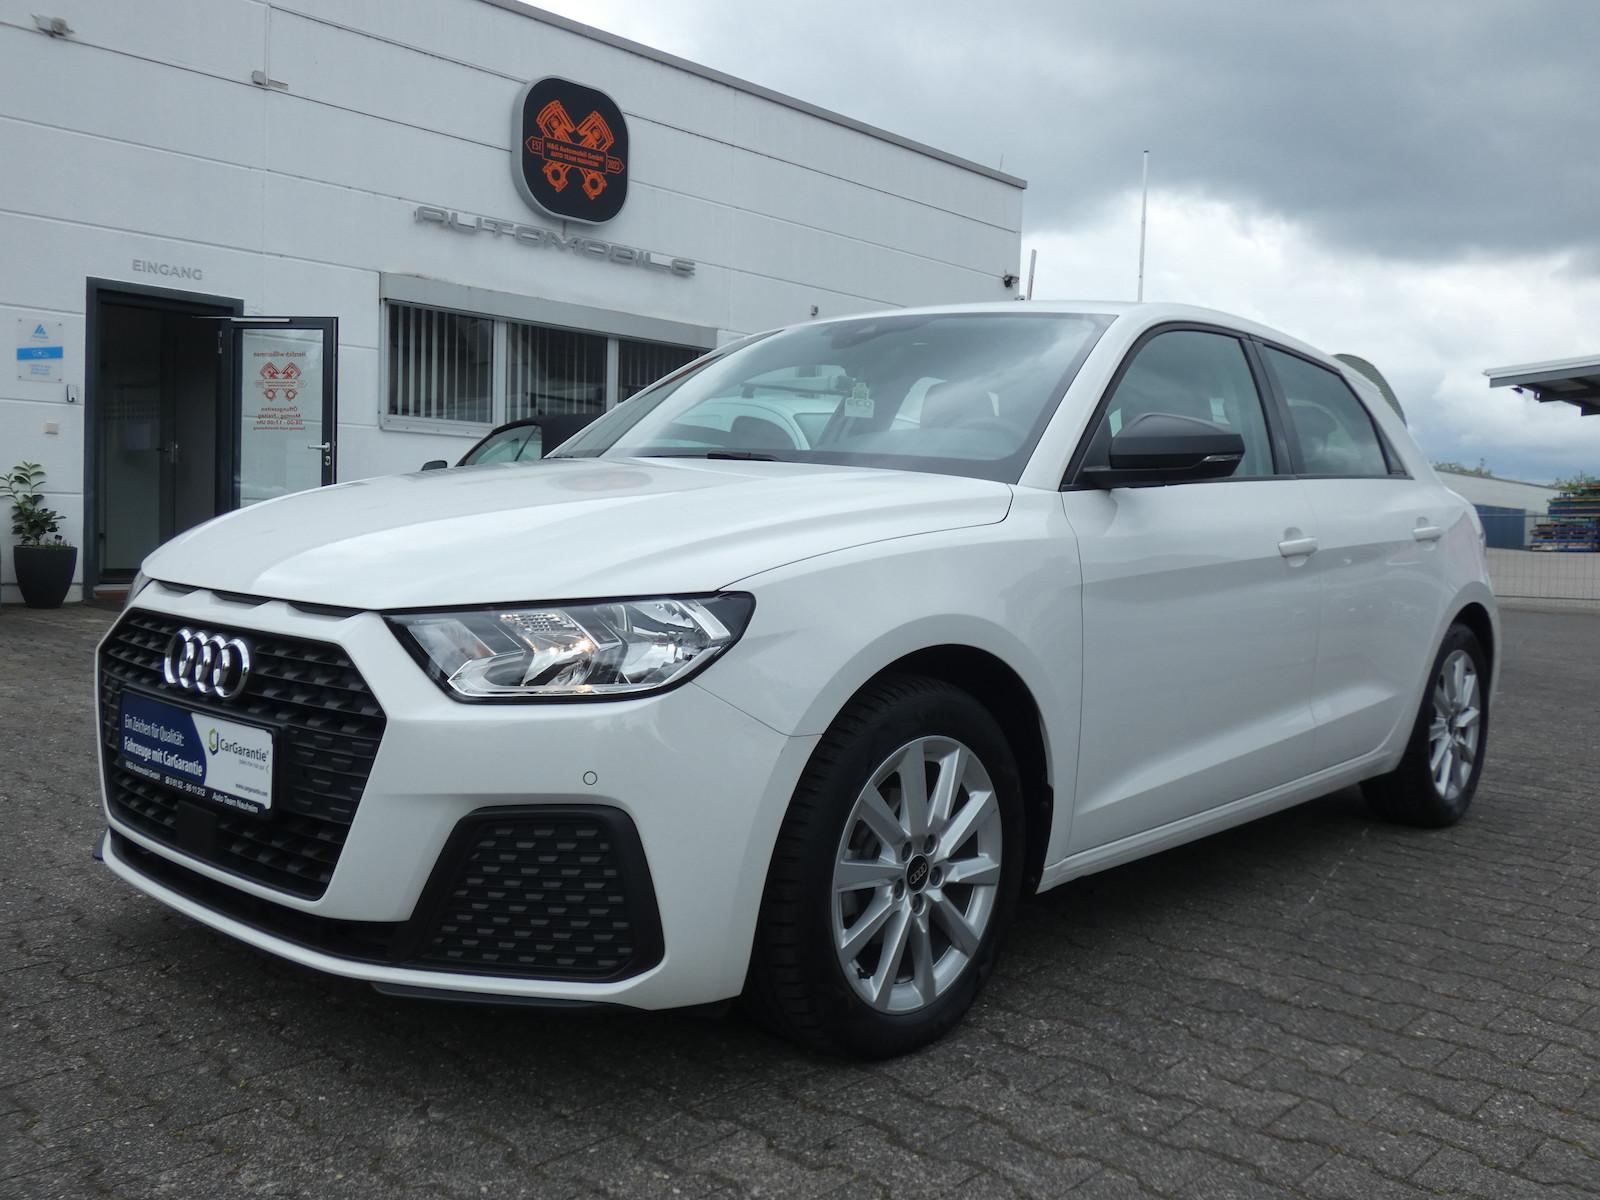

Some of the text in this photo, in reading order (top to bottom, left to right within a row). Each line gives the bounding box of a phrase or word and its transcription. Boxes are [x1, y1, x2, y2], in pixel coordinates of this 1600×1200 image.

[531, 140, 542, 152] EST
[414, 206, 696, 277] AUTOMOBILE
[132, 259, 203, 280] EINGANG
[124, 713, 133, 729] Ein
[132, 716, 151, 736] Zeichen
[151, 722, 160, 739] für
[124, 735, 203, 776] Fahrzeuge mit CarGarantie
[212, 792, 224, 802] Auto
